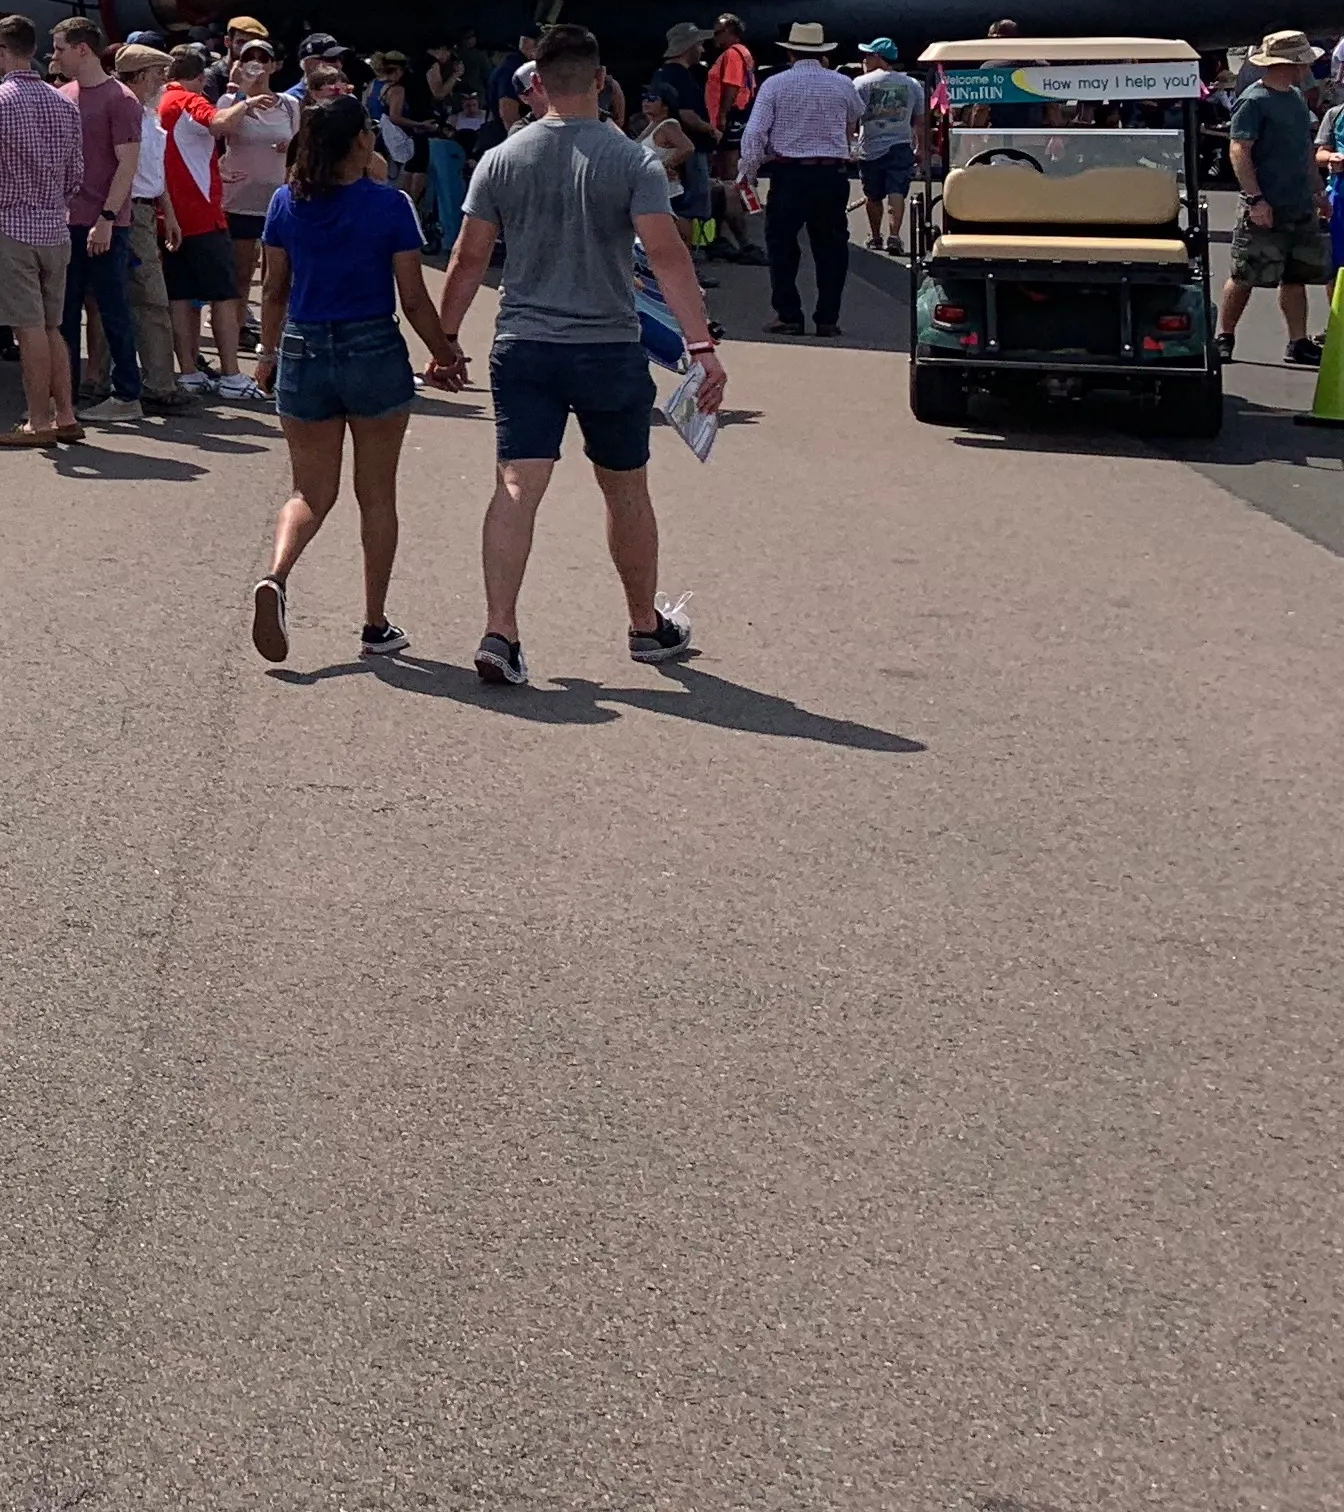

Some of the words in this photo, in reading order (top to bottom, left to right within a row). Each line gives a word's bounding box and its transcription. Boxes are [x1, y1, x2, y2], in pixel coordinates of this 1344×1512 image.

[993, 74, 1005, 84] to
[1043, 78, 1071, 91] How
[1078, 79, 1108, 93] may
[1114, 76, 1119, 88] I
[1125, 74, 1156, 91] help
[1164, 73, 1198, 90] you?
